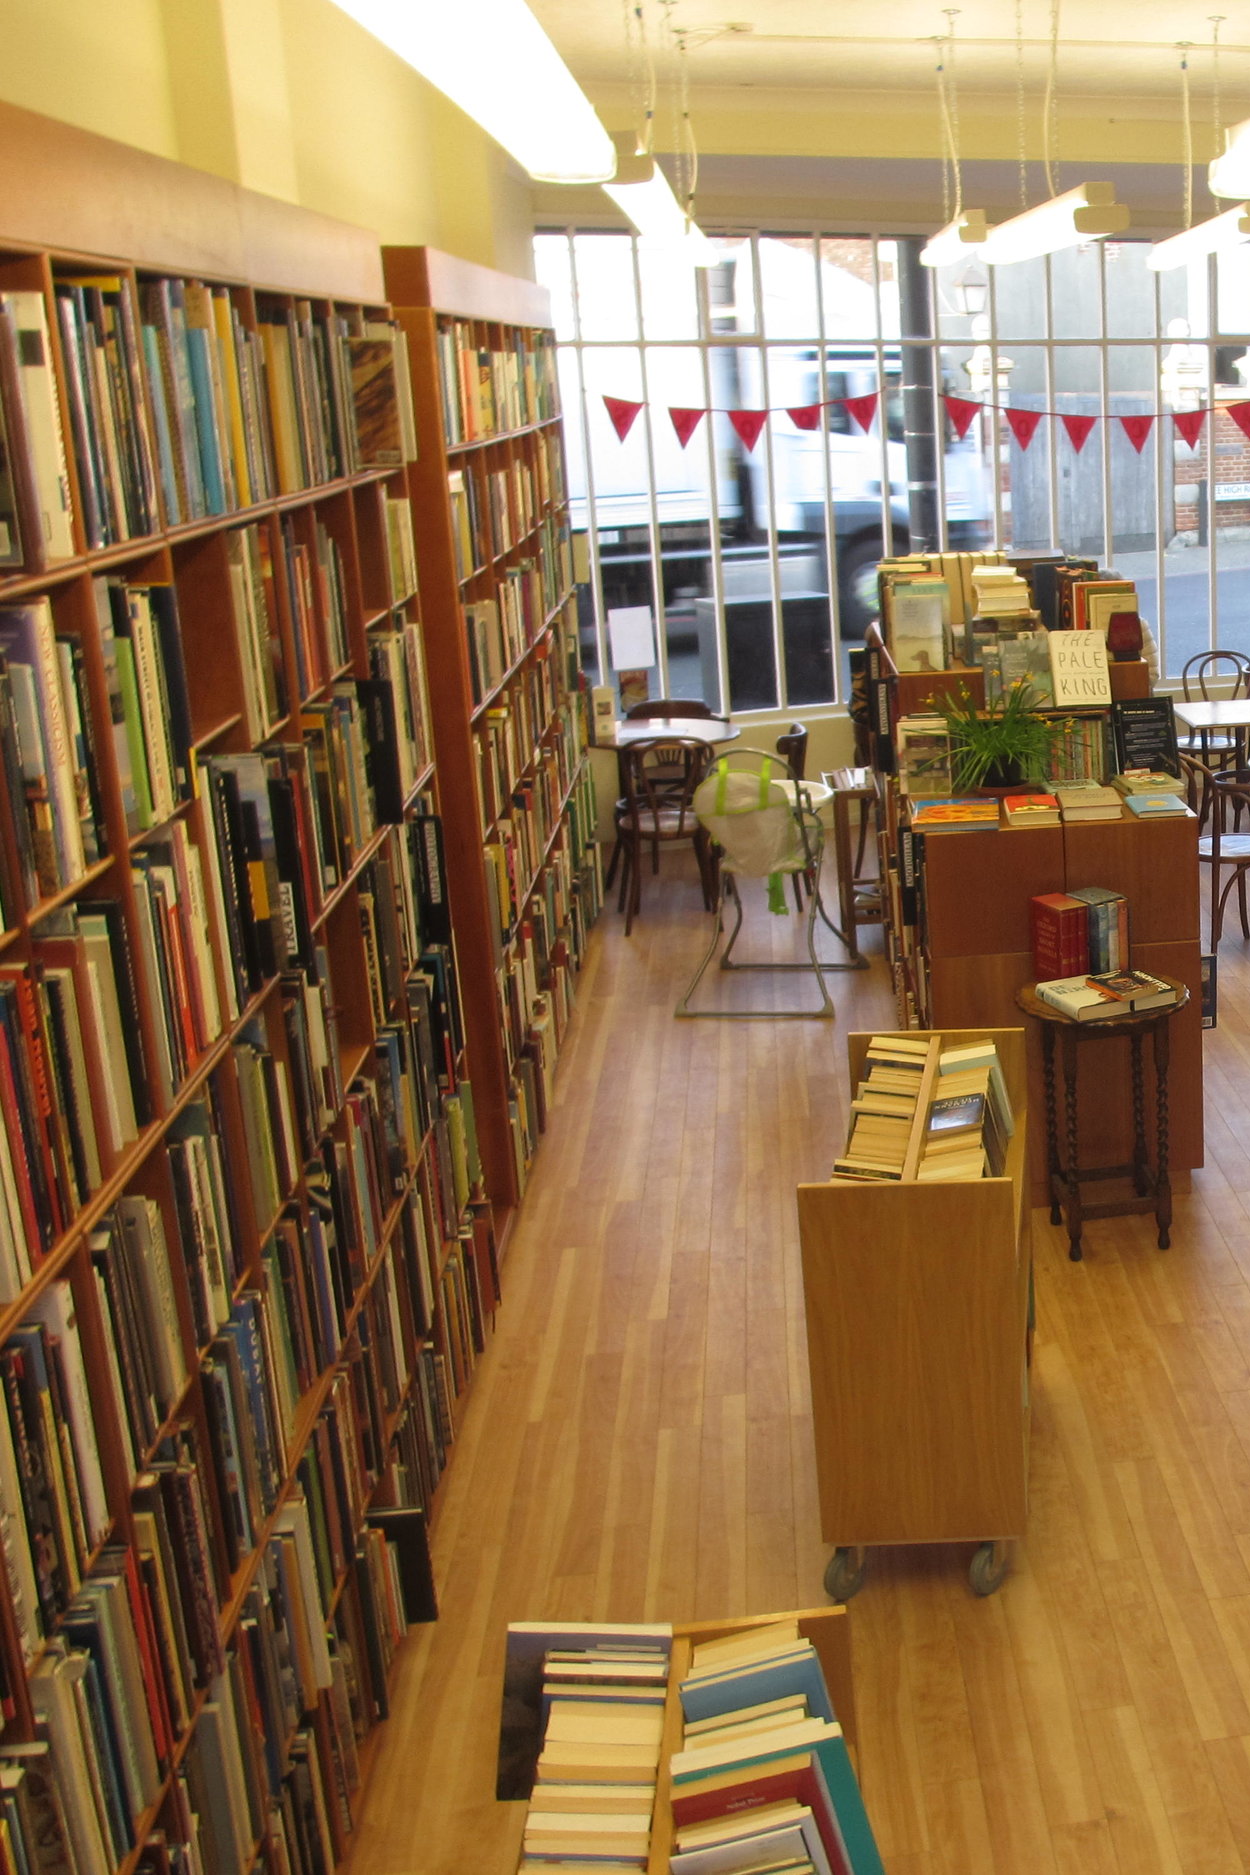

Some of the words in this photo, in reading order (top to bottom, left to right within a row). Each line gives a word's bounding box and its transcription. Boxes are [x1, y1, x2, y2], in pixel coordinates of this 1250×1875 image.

[1061, 633, 1095, 647] THE
[1058, 650, 1104, 669] PALE
[1060, 678, 1108, 696] KING
[281, 884, 298, 956] TRAVEL
